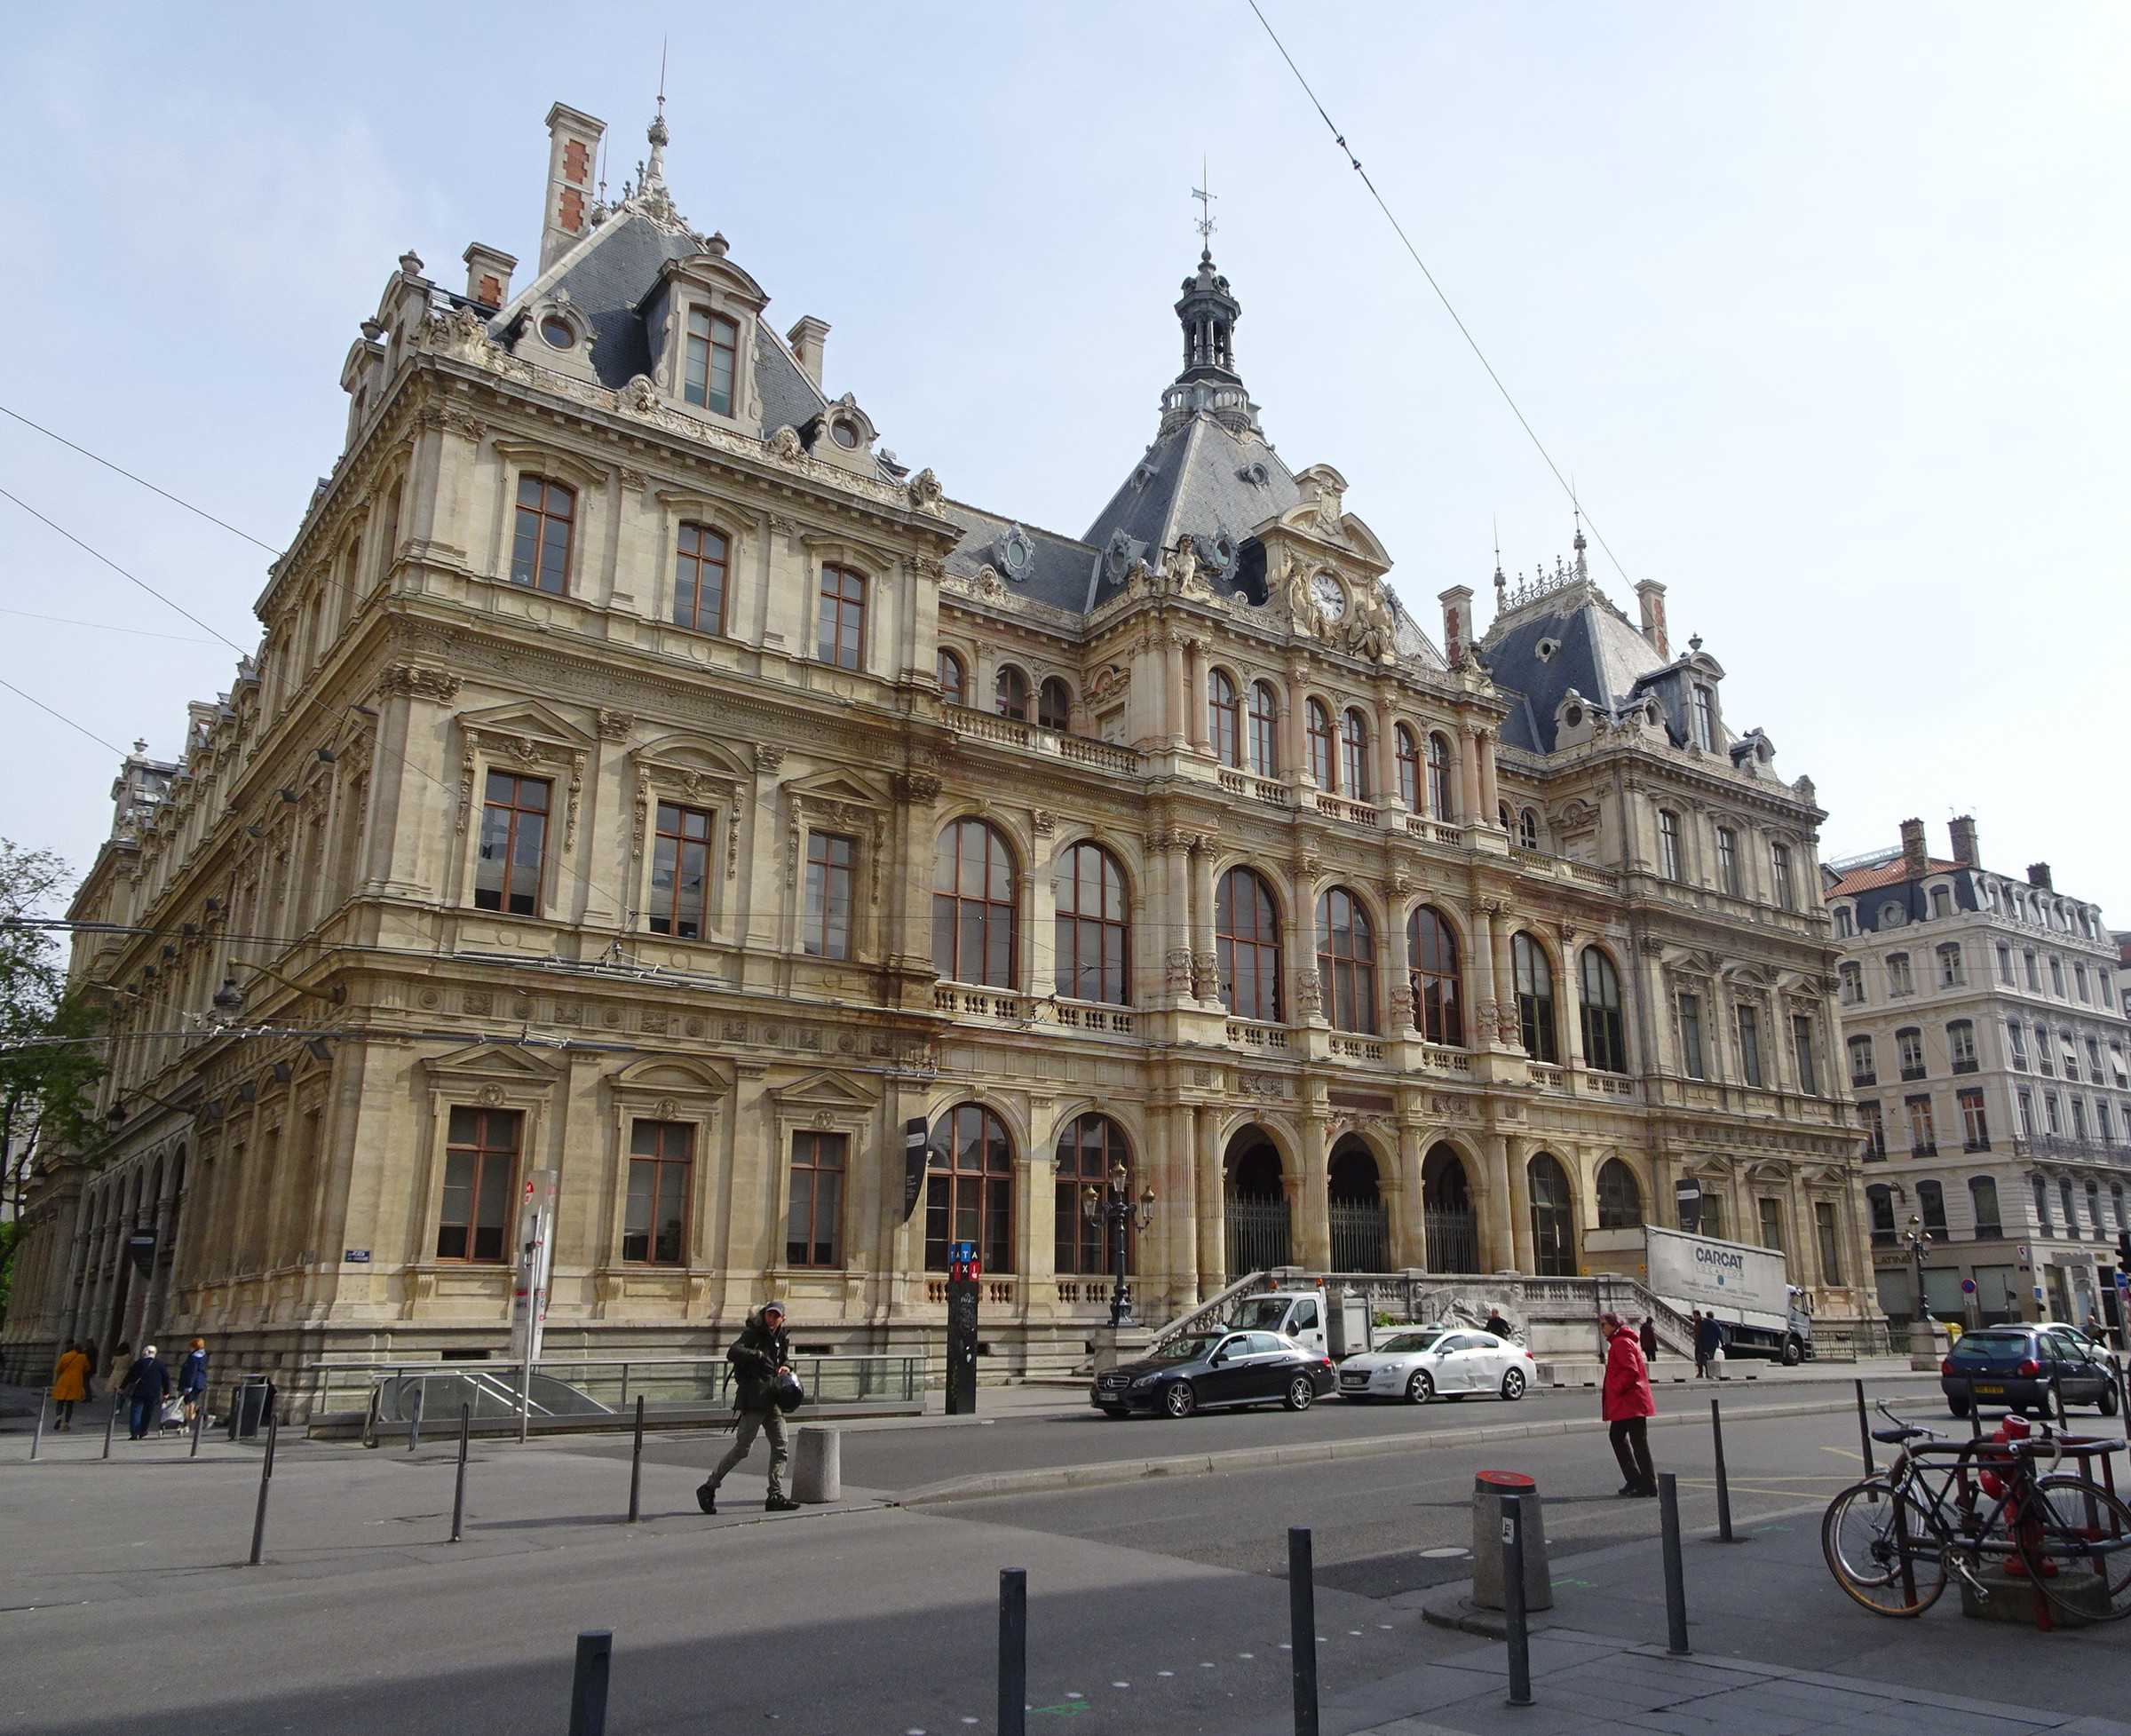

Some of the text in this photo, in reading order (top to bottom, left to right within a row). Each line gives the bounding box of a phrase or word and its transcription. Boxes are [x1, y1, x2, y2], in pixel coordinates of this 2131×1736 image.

[963, 1250, 978, 1259] TA
[1696, 1247, 1744, 1270] CARCAT
[963, 1264, 976, 1273] XI
[1696, 1264, 1745, 1279] LOCATION
